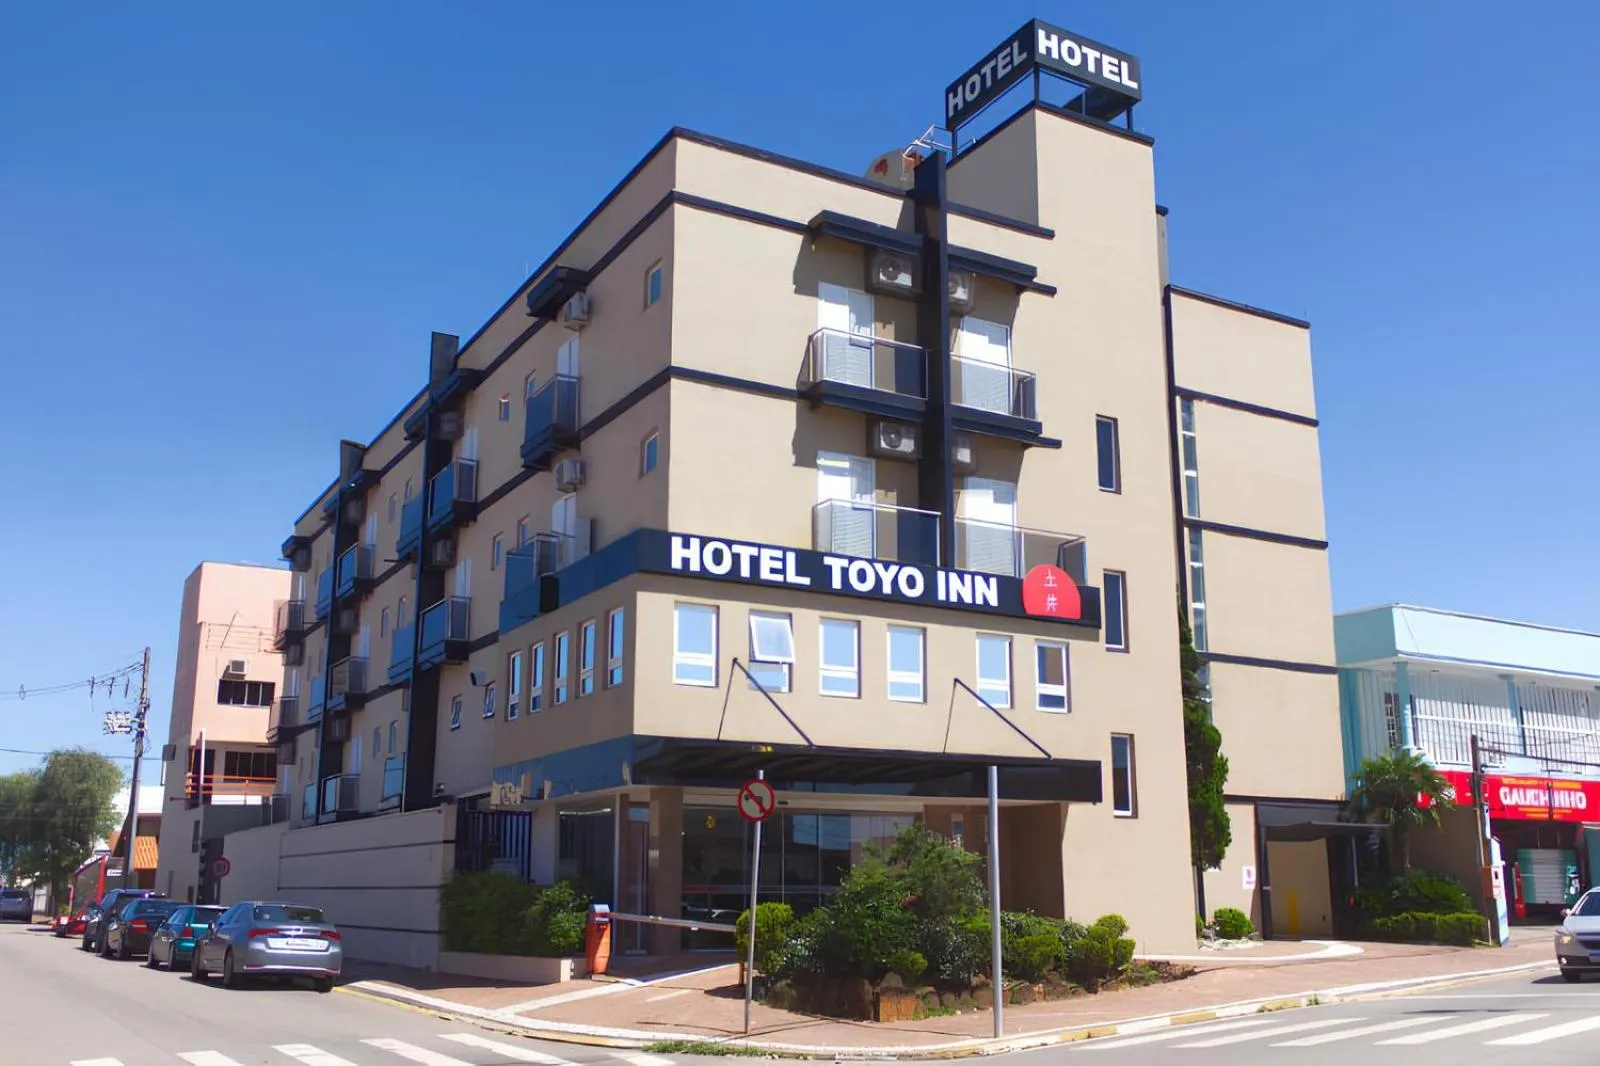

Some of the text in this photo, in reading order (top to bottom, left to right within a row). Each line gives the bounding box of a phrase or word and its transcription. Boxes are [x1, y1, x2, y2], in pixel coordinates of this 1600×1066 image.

[948, 40, 1028, 117] HOTEL
[1037, 29, 1138, 89] HOTEL
[671, 535, 999, 607] HOTEL TOYO INN
[1499, 786, 1587, 809] GAUCHNHO
